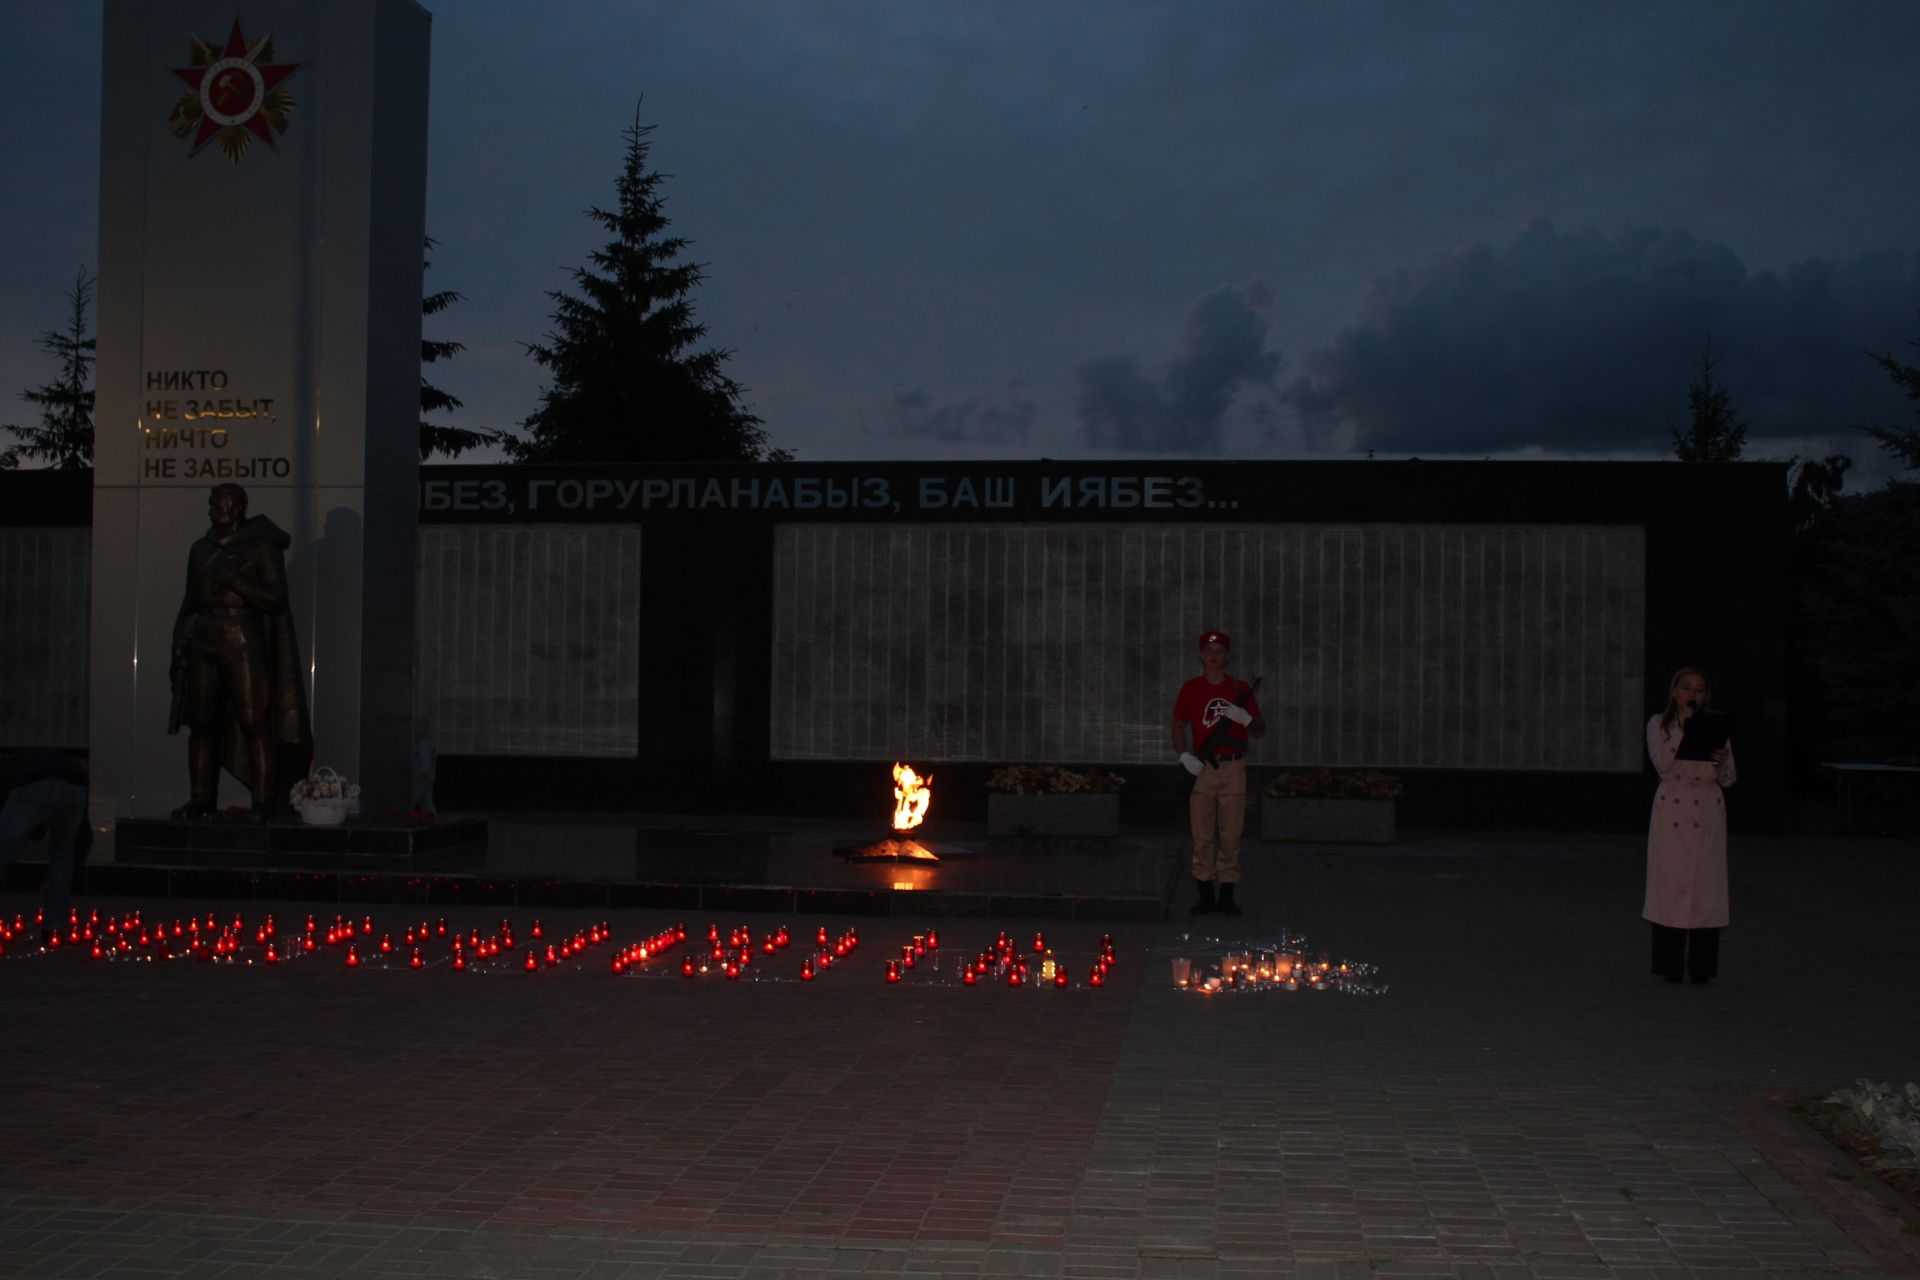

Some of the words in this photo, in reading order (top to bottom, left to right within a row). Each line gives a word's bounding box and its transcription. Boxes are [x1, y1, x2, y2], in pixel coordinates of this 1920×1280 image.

[147, 370, 228, 391] НИКТО
[146, 401, 177, 420] НЕ
[184, 399, 279, 422] ЗАБЫТ,
[145, 429, 228, 449] НИЧТО
[145, 458, 176, 478] НЕ
[183, 457, 290, 478] ЗАБЫТО
[417, 479, 516, 516] БЕЗ,
[528, 477, 902, 514] ГОРУРЛАНАБЫЗ,
[918, 476, 1016, 509] БАШ
[1041, 476, 1240, 509] ИЯБЕЗ...
